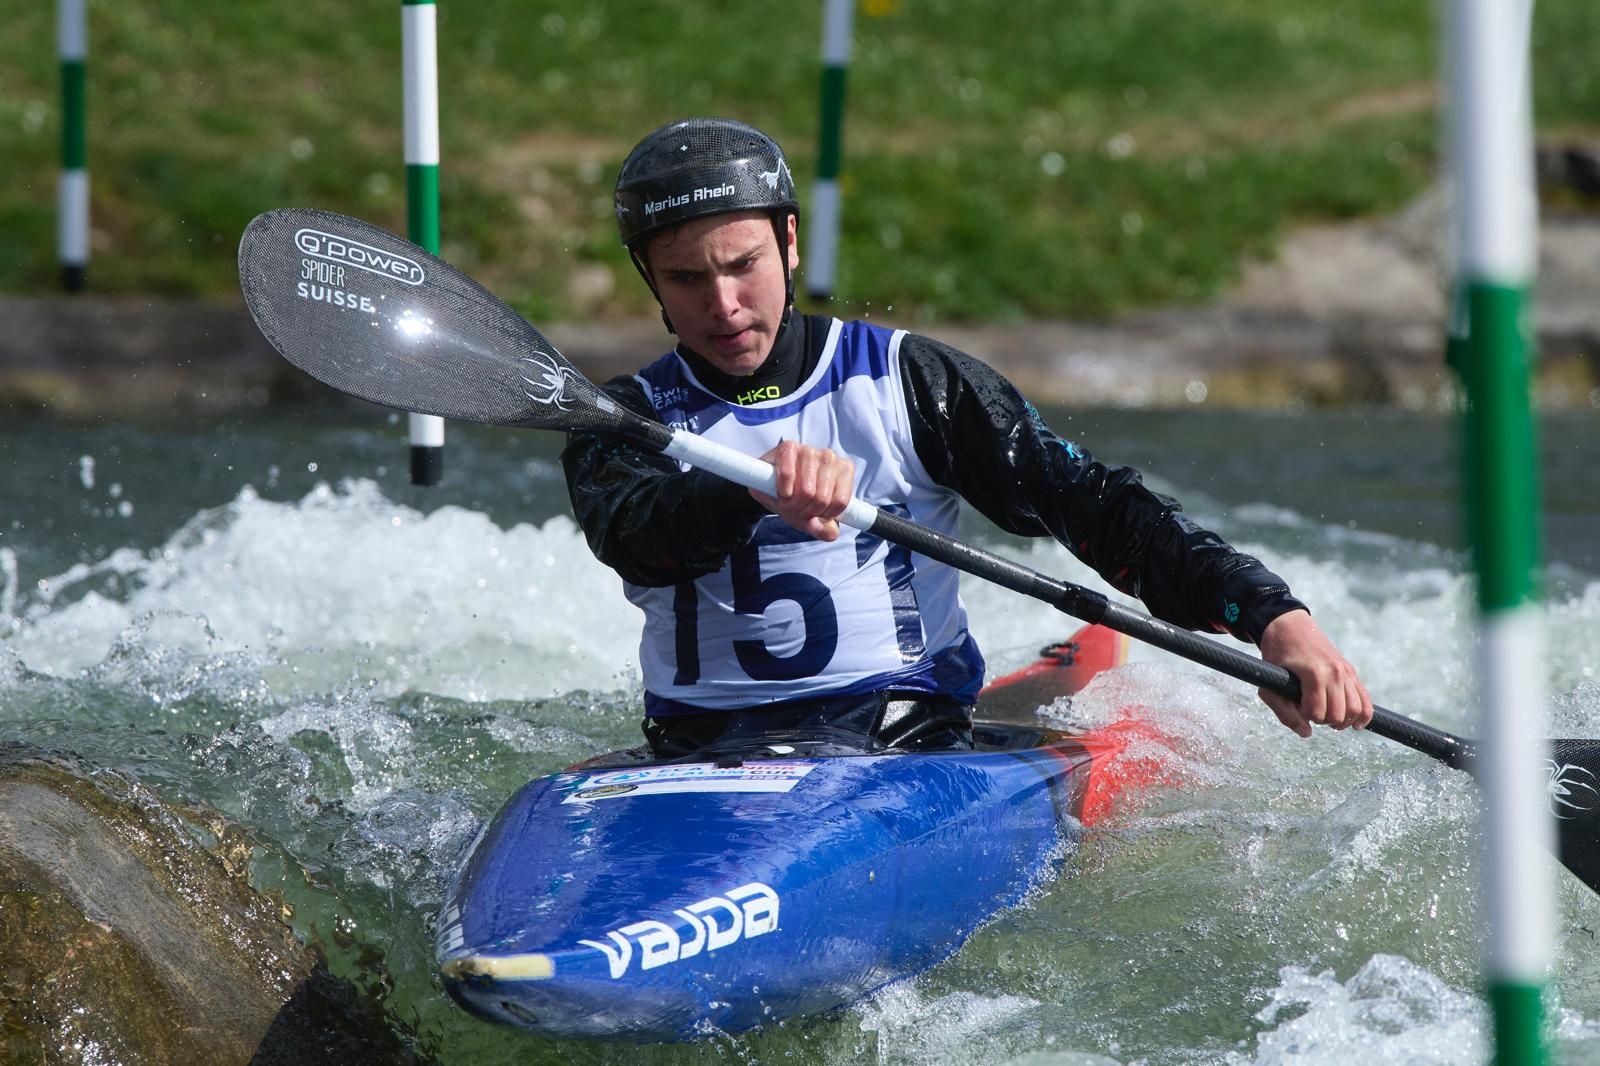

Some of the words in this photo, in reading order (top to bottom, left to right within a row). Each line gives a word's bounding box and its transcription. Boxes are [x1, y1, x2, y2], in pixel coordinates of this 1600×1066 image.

[645, 194, 690, 215] Marius
[693, 183, 735, 202] Rhein
[301, 259, 345, 287] SPIDER
[297, 283, 372, 312] SUISSE
